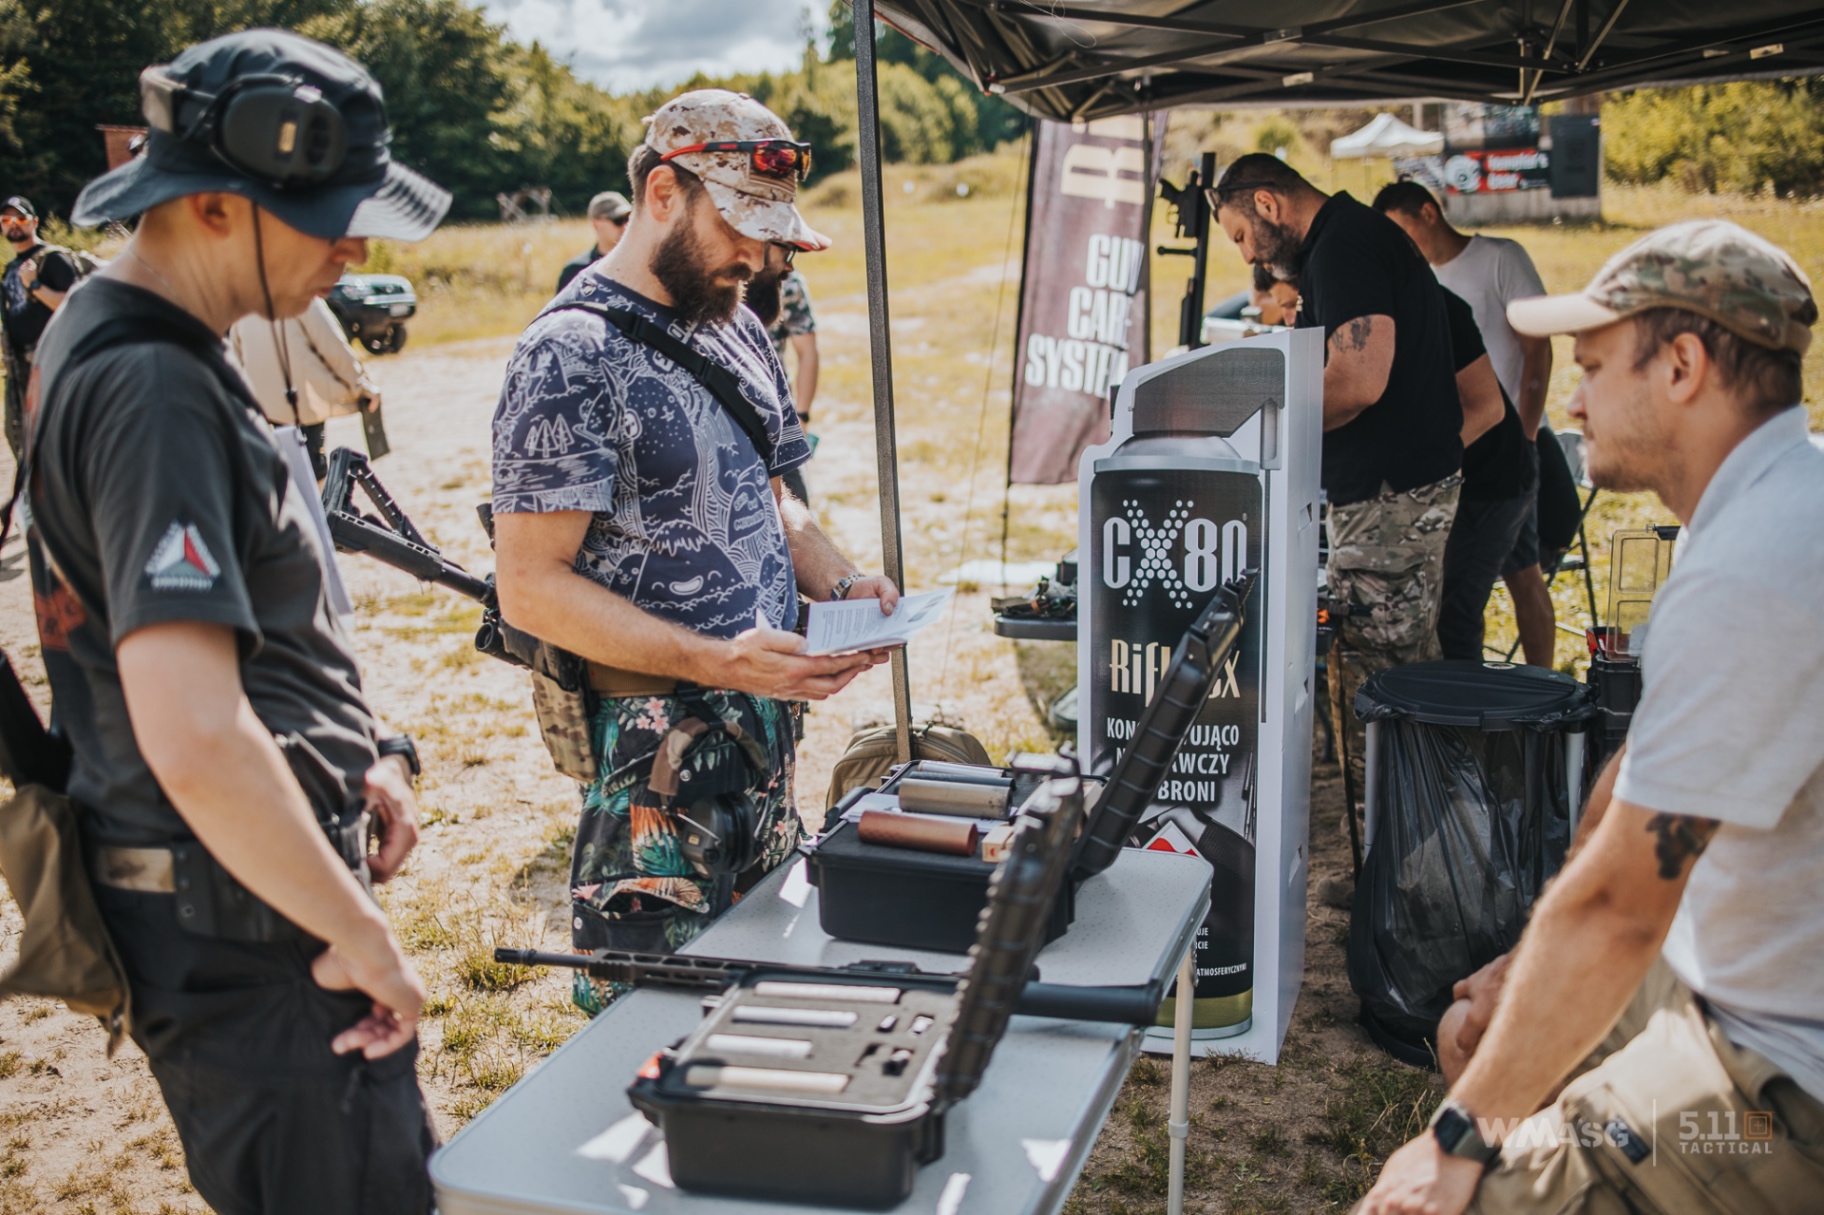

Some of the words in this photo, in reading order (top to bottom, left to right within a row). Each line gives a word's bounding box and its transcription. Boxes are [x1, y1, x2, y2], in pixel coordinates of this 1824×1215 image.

[1103, 499, 1247, 609] CX80
[1109, 639, 1240, 707] RiflX
[1106, 717, 1239, 751] KONUJĄCO
[1157, 780, 1216, 802] BRONI
